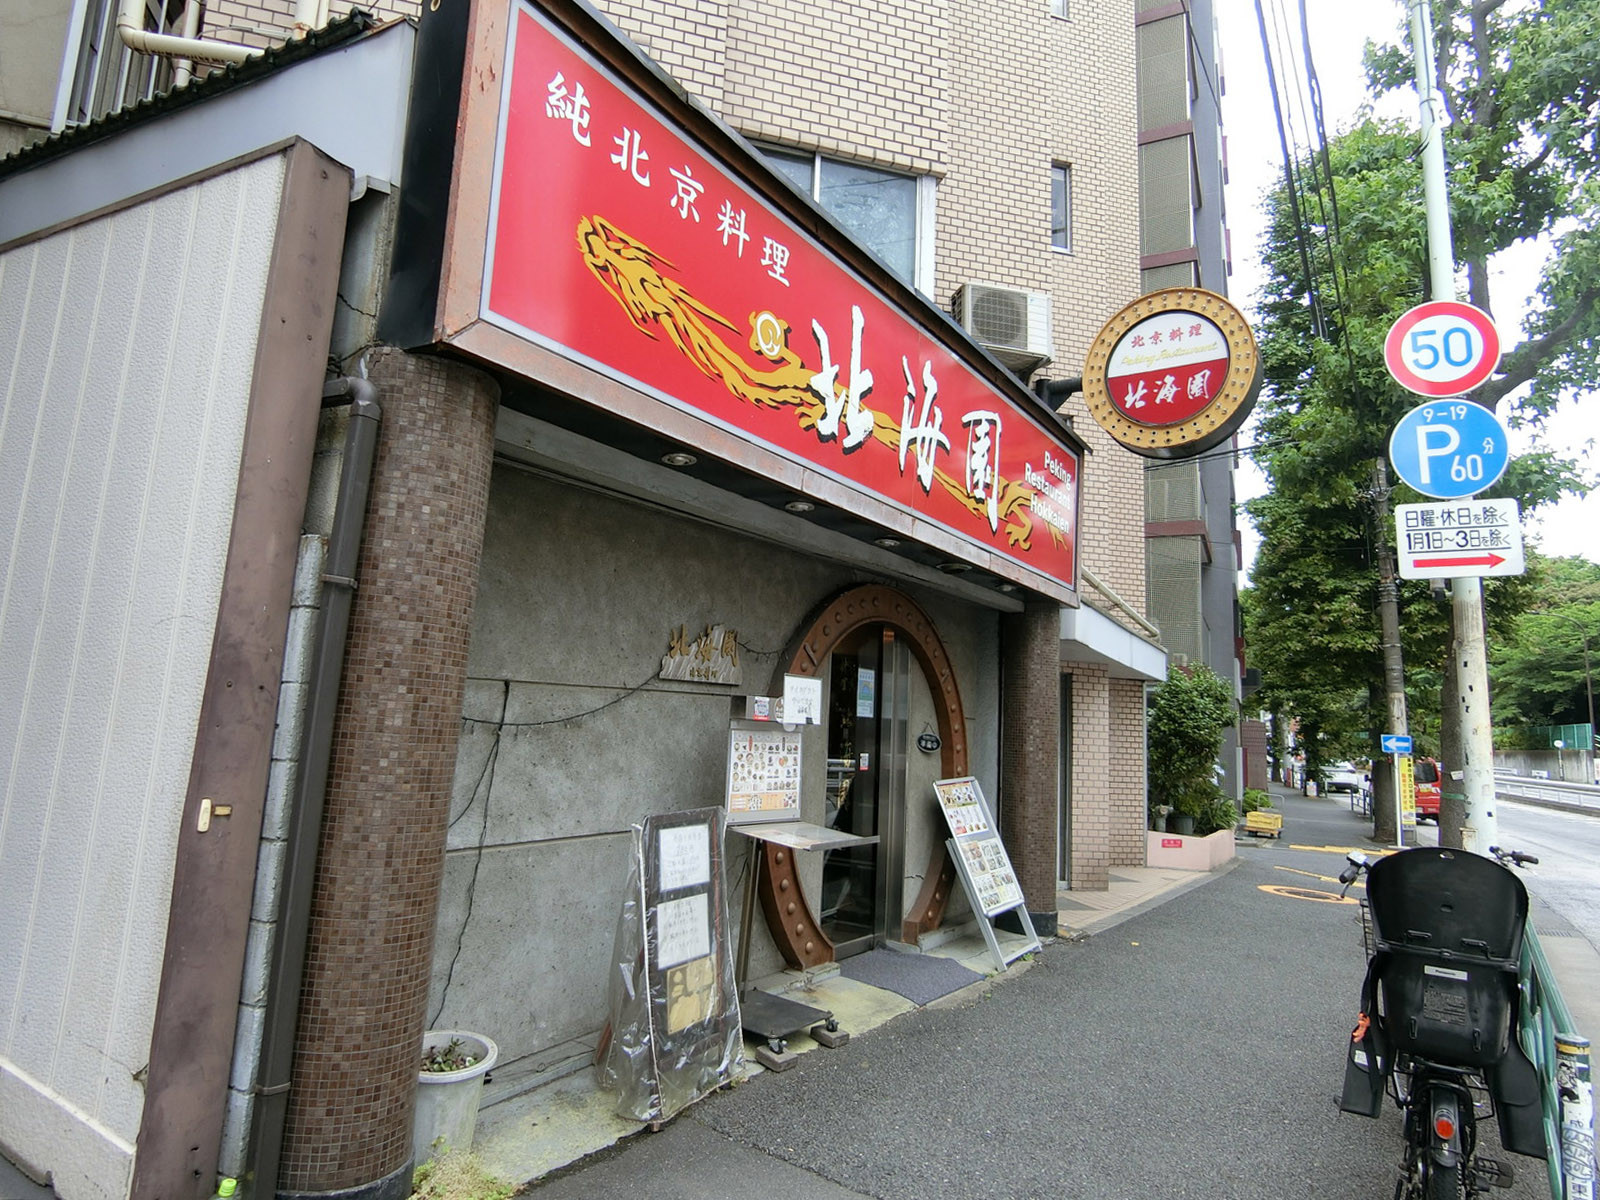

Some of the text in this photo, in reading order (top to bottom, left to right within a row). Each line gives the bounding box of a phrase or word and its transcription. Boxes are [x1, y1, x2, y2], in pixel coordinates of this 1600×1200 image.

[545, 71, 791, 287] 純北京料理
[1131, 323, 1203, 348] 北京料理
[1410, 326, 1474, 370] 50
[1422, 405, 1468, 423] 9-19
[1044, 450, 1072, 491] Peking
[1416, 423, 1461, 485] P
[1450, 437, 1495, 482] 60 分
[1024, 462, 1071, 510] Restaurant
